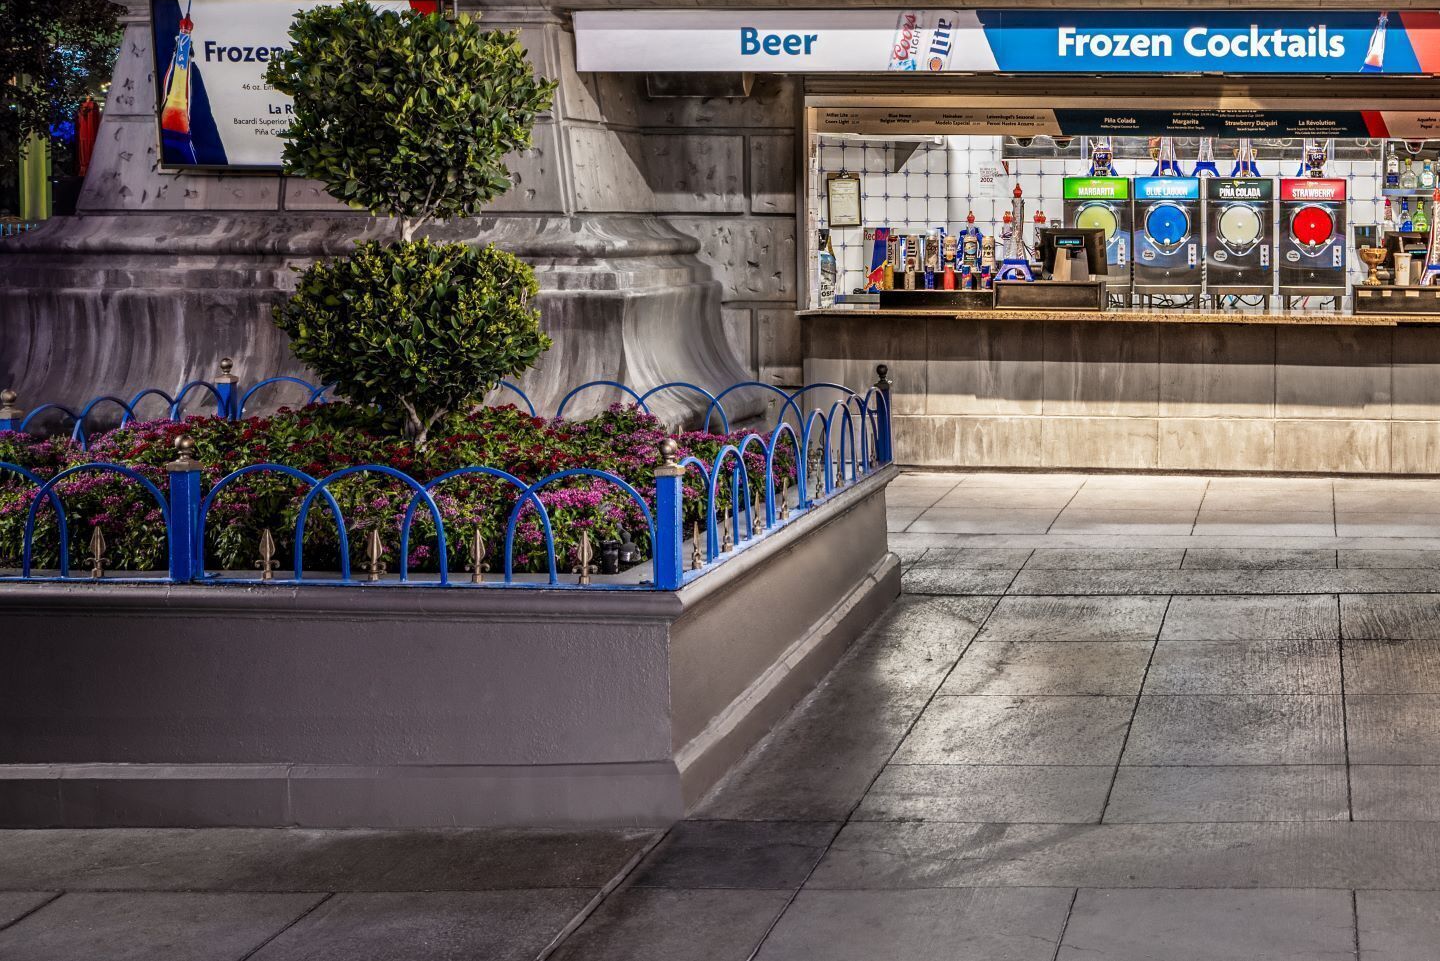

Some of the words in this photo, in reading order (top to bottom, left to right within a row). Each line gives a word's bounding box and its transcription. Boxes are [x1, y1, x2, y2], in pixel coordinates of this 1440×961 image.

[740, 26, 818, 56] Beer
[893, 13, 916, 60] Coors
[910, 24, 922, 55] LIGHT
[929, 18, 952, 56] Lite
[1058, 26, 1172, 57] Frozen
[1183, 24, 1345, 58] Cocktails
[242, 83, 250, 91] 46
[268, 103, 282, 115] La
[233, 117, 258, 125] Bacardi
[258, 117, 287, 126] Superior
[1172, 118, 1199, 126] Margarita
[1225, 120, 1255, 128] Strawberry
[1256, 120, 1278, 128] Daiquiri
[254, 128, 269, 136] Piña
[1078, 187, 1115, 196] MARGARITA
[1145, 187, 1162, 196] BLUE
[1219, 185, 1235, 197] PIÑA
[1235, 187, 1261, 197] COLADA
[1292, 188, 1335, 198] STRAWBERRY
[863, 229, 875, 241] Red
